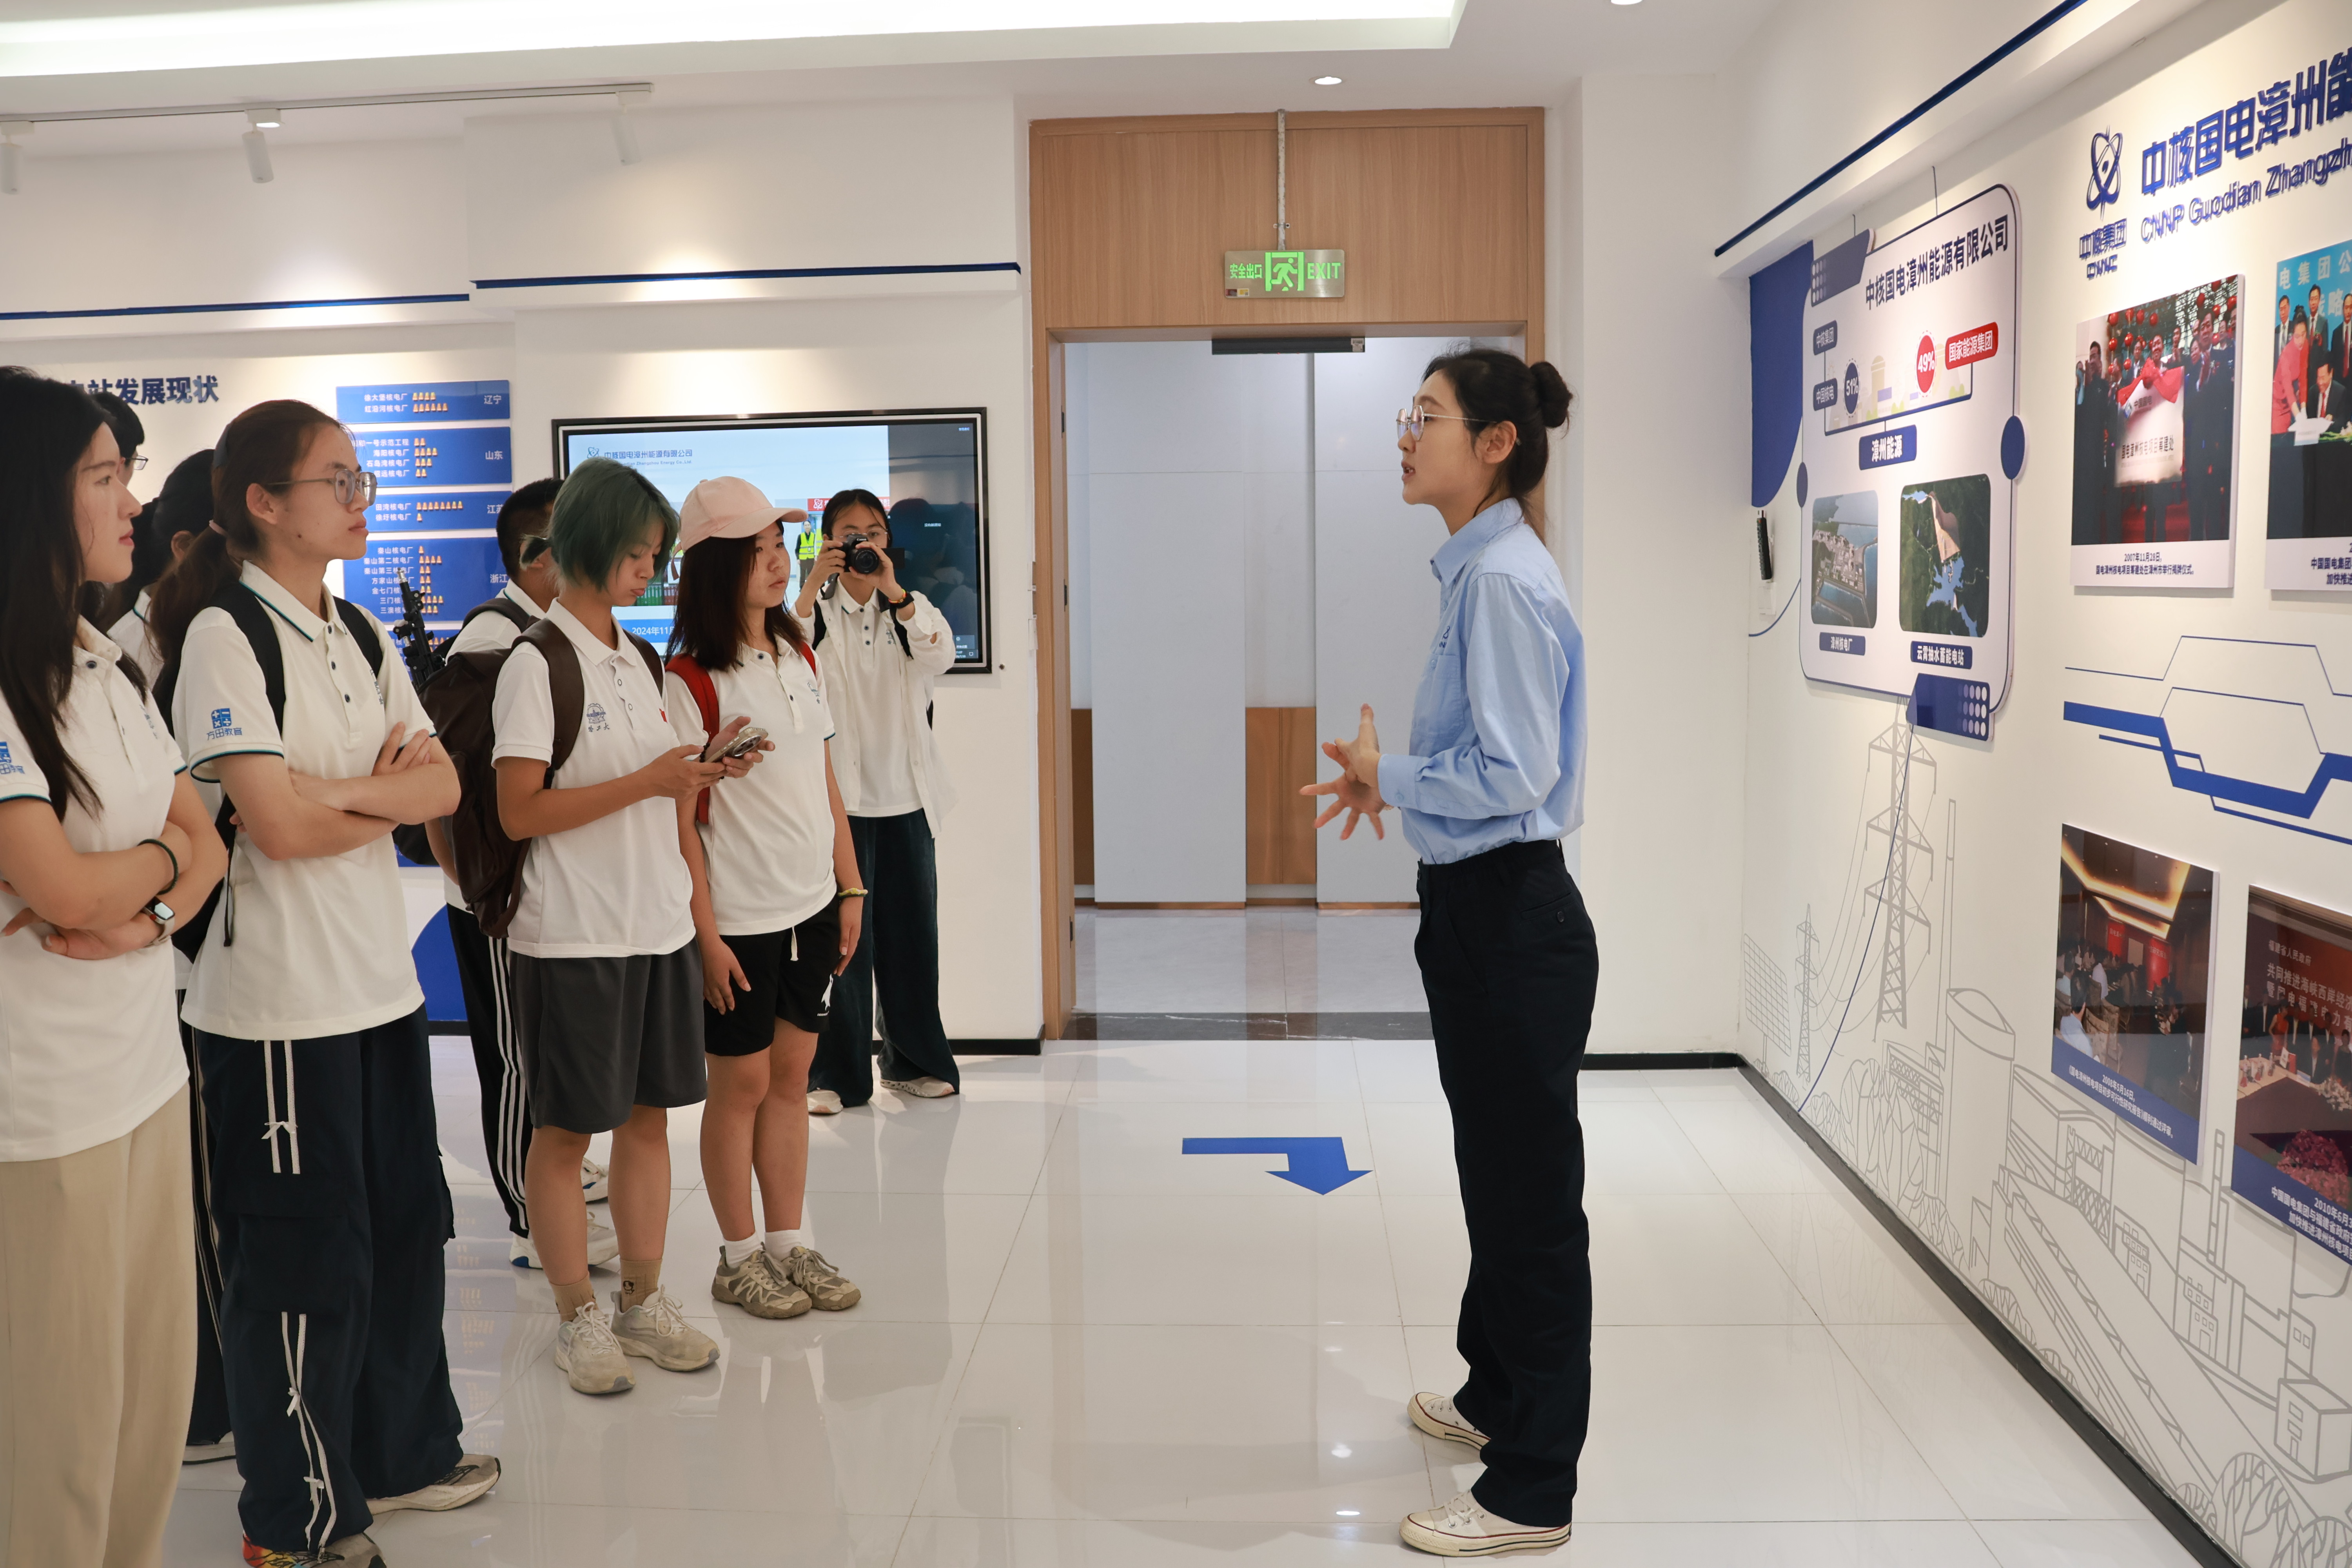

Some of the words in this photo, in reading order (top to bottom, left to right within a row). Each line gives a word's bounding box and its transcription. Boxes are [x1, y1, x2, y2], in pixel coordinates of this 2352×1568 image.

[2141, 204, 2185, 244] CNNP
[2189, 180, 2262, 226] Guodian
[2079, 218, 2127, 260] 中核集团
[1230, 263, 1263, 279] 安全出口
[1307, 262, 1341, 279] EXIT
[1866, 214, 2008, 310] 中核国电漳州能源有限公司
[1816, 327, 1835, 348] 中核集团
[1949, 330, 1993, 363] 国家能源集团
[1917, 350, 1935, 373] 49%
[70, 375, 220, 405] 站发展现状
[1816, 384, 1835, 404] 中国核电
[1846, 376, 1858, 396] 51%
[364, 393, 408, 402] 徐大堡核电厂
[483, 394, 502, 405] 辽宁
[485, 450, 503, 461] 山东
[604, 449, 693, 459] 中核国电漳州能源有限公司
[1871, 435, 1902, 462] 漳州能源
[366, 459, 410, 467] 石岛湾核电厂
[486, 504, 505, 514] 江苏
[363, 557, 414, 565] 秦山第二核电厂
[490, 573, 508, 584] 浙江
[1831, 636, 1853, 651] 漳州核电厂
[1917, 646, 1964, 666] 云霄抽水蓄能电站
